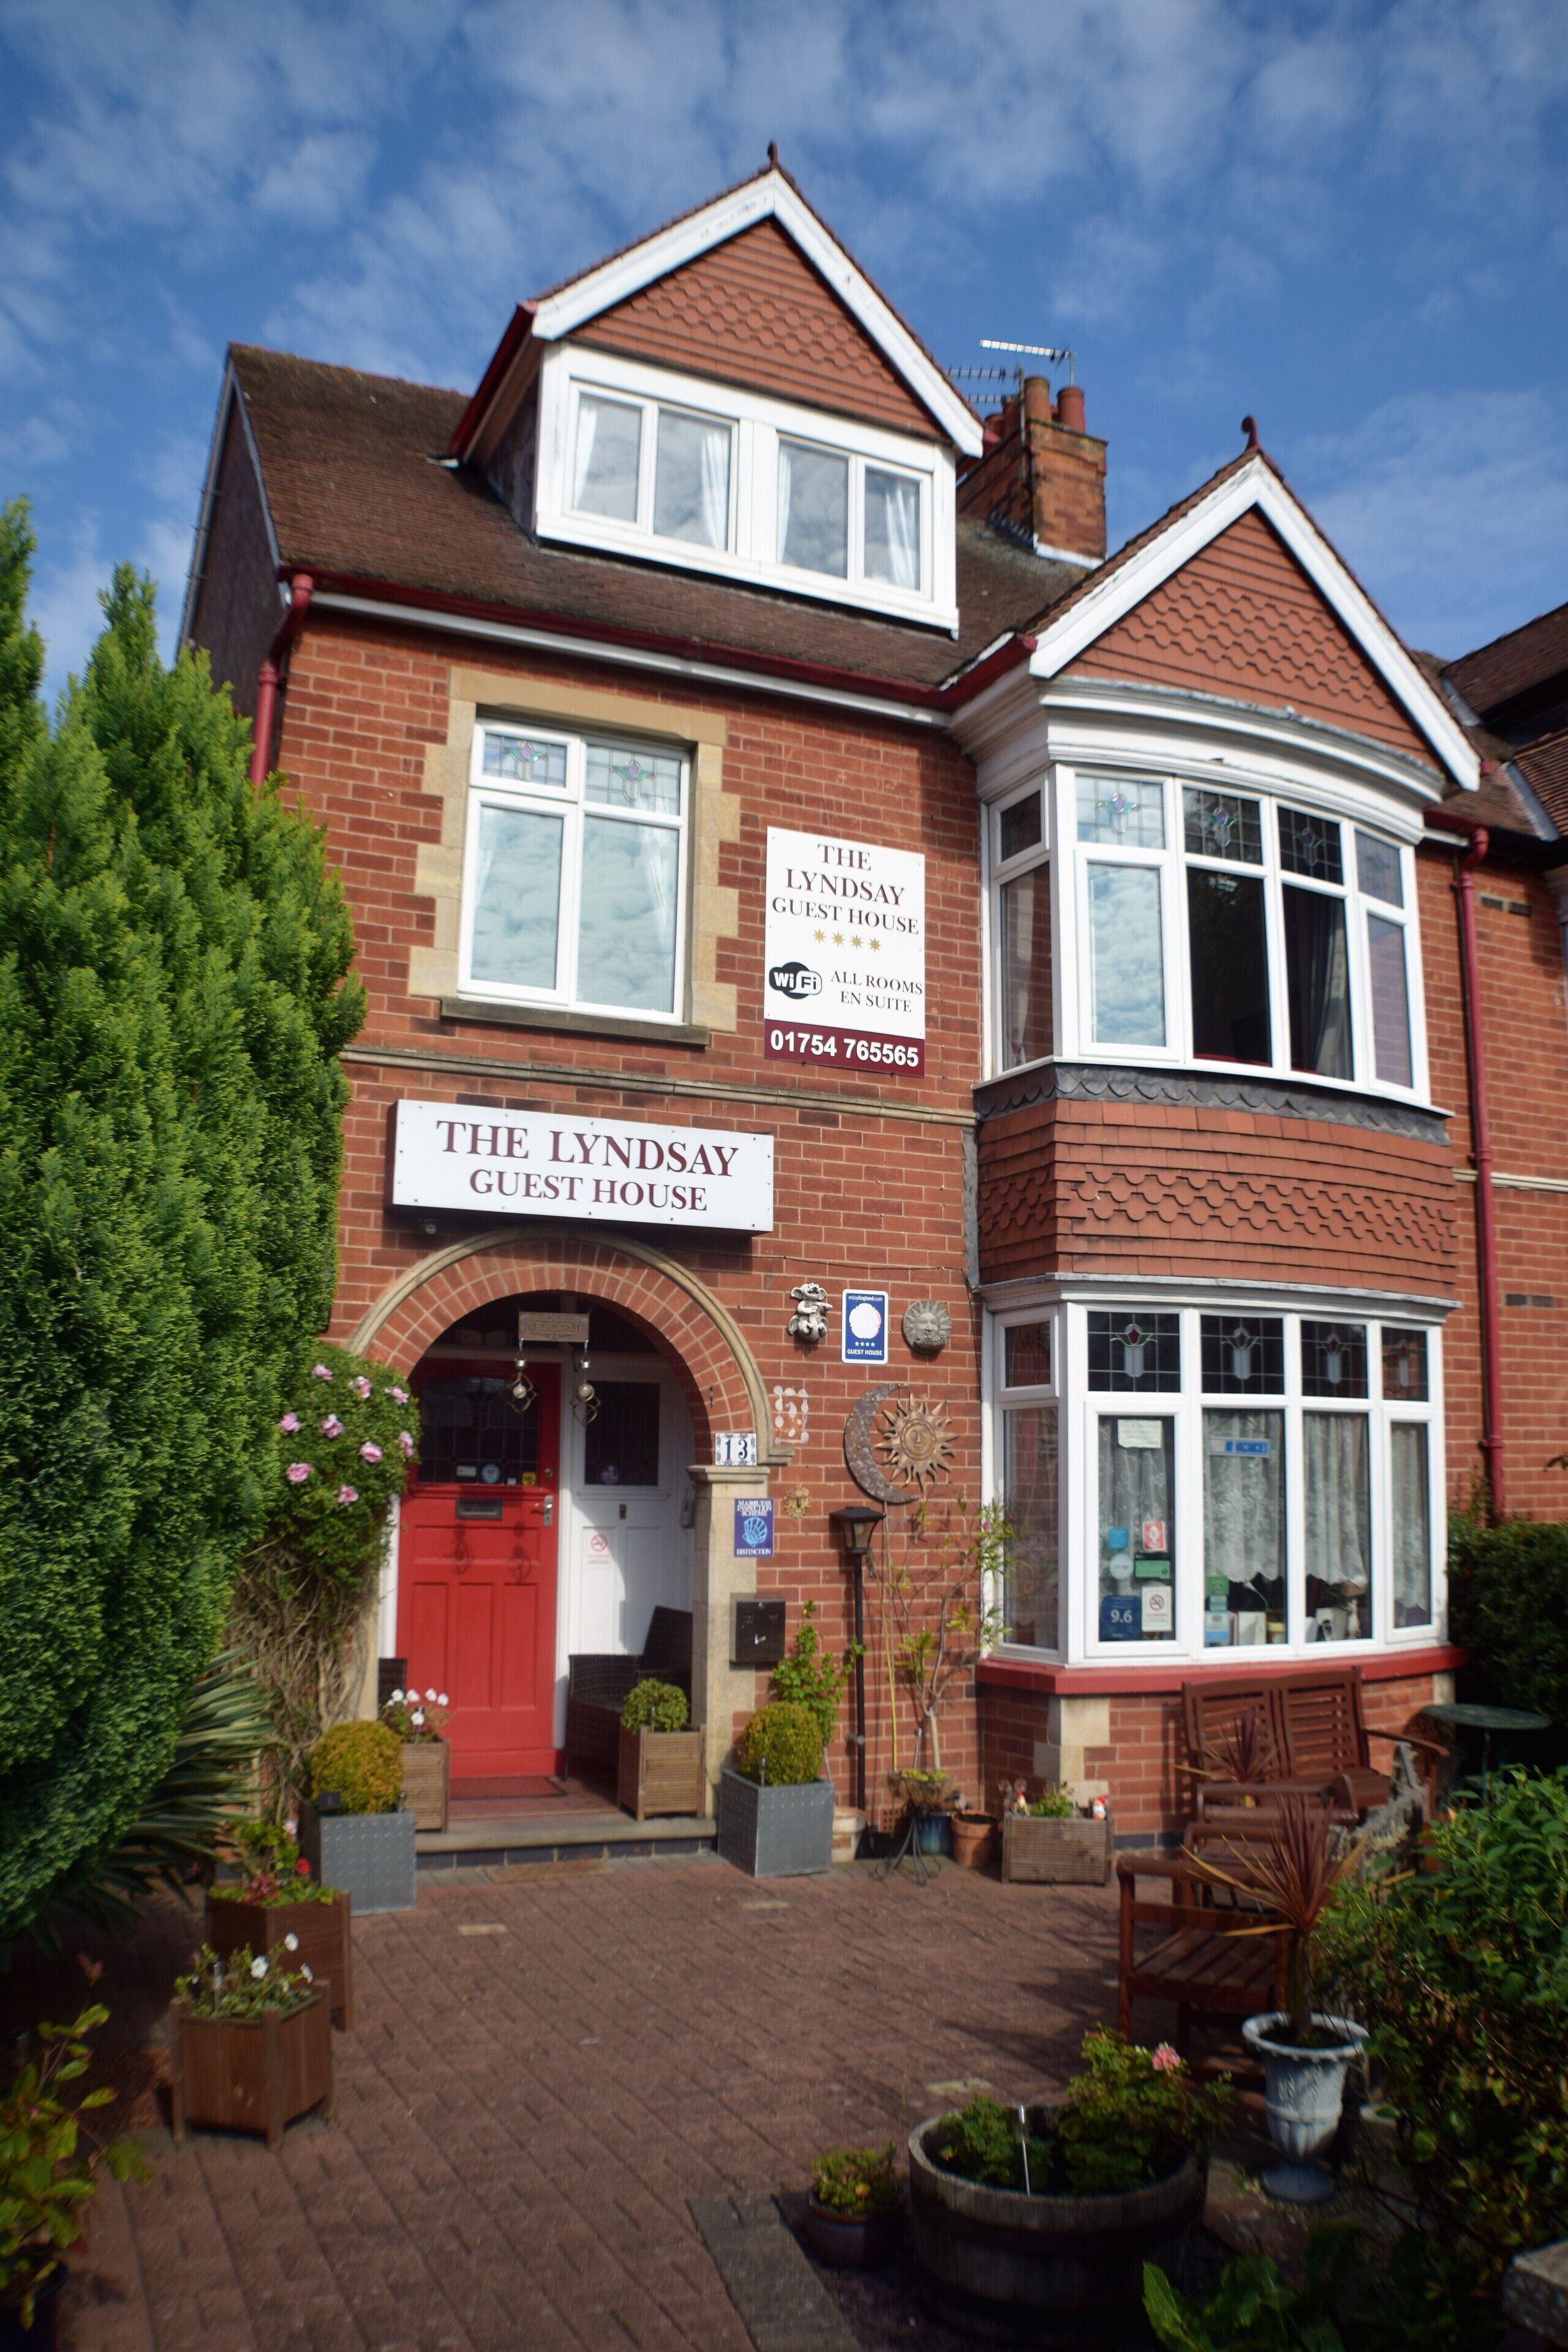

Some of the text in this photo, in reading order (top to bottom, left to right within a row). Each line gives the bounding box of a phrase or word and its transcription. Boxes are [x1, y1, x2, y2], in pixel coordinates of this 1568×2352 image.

[818, 843, 871, 871] THE
[785, 868, 905, 906] LYNDSAY
[772, 897, 919, 935] GUEST HOUSE
[831, 970, 923, 995] ALL ROOMS
[840, 990, 912, 1013] EN SUITE
[771, 1030, 919, 1068] 01754 765565
[437, 1120, 739, 1177] THE LYNDSAY
[470, 1169, 707, 1212] GUEST HOUSE
[725, 1439, 748, 1460] 13
[1110, 1608, 1133, 1624] 9.6
